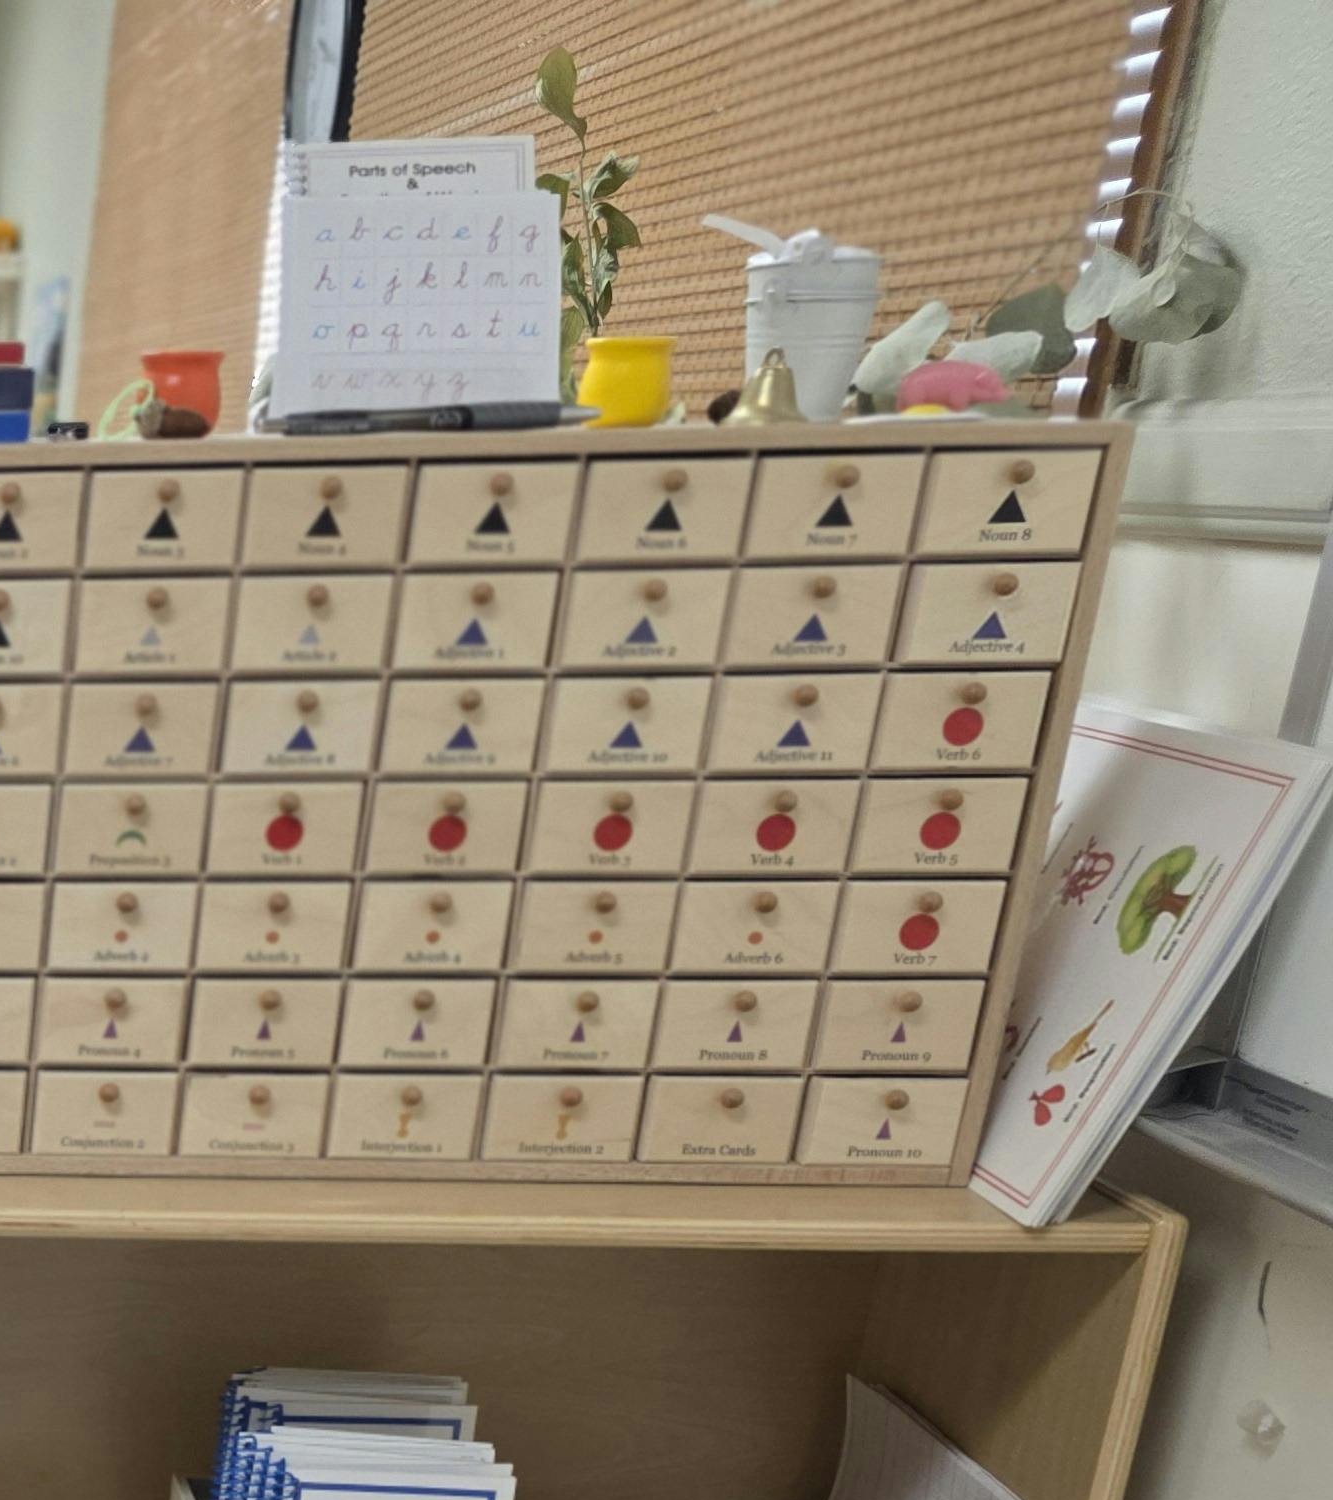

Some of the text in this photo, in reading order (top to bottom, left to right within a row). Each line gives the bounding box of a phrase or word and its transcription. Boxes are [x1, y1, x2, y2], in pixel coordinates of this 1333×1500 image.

[349, 161, 476, 178] Parts of Speech
[805, 532, 844, 547] Noun
[978, 527, 1032, 543] Noun 8
[948, 641, 1026, 656] Adjective 4
[586, 750, 647, 766] Adjective
[753, 749, 816, 764] Adjective
[935, 748, 982, 762] Verb 6
[588, 853, 620, 867] Verb
[750, 853, 796, 869] Verb 4
[914, 851, 960, 867] Verb 5
[564, 951, 609, 964] Adverb
[723, 952, 784, 965] Adverb 6
[893, 952, 923, 966] Verb
[542, 1049, 597, 1062] Pronoun
[697, 1048, 769, 1062] Pronoun 8
[861, 1049, 933, 1065] Pronoun 9
[60, 1135, 133, 1152] Conjunction
[517, 1141, 592, 1156] Interjection
[681, 1143, 757, 1158] Extra Cards
[846, 1145, 923, 1160] Pronoun 10
